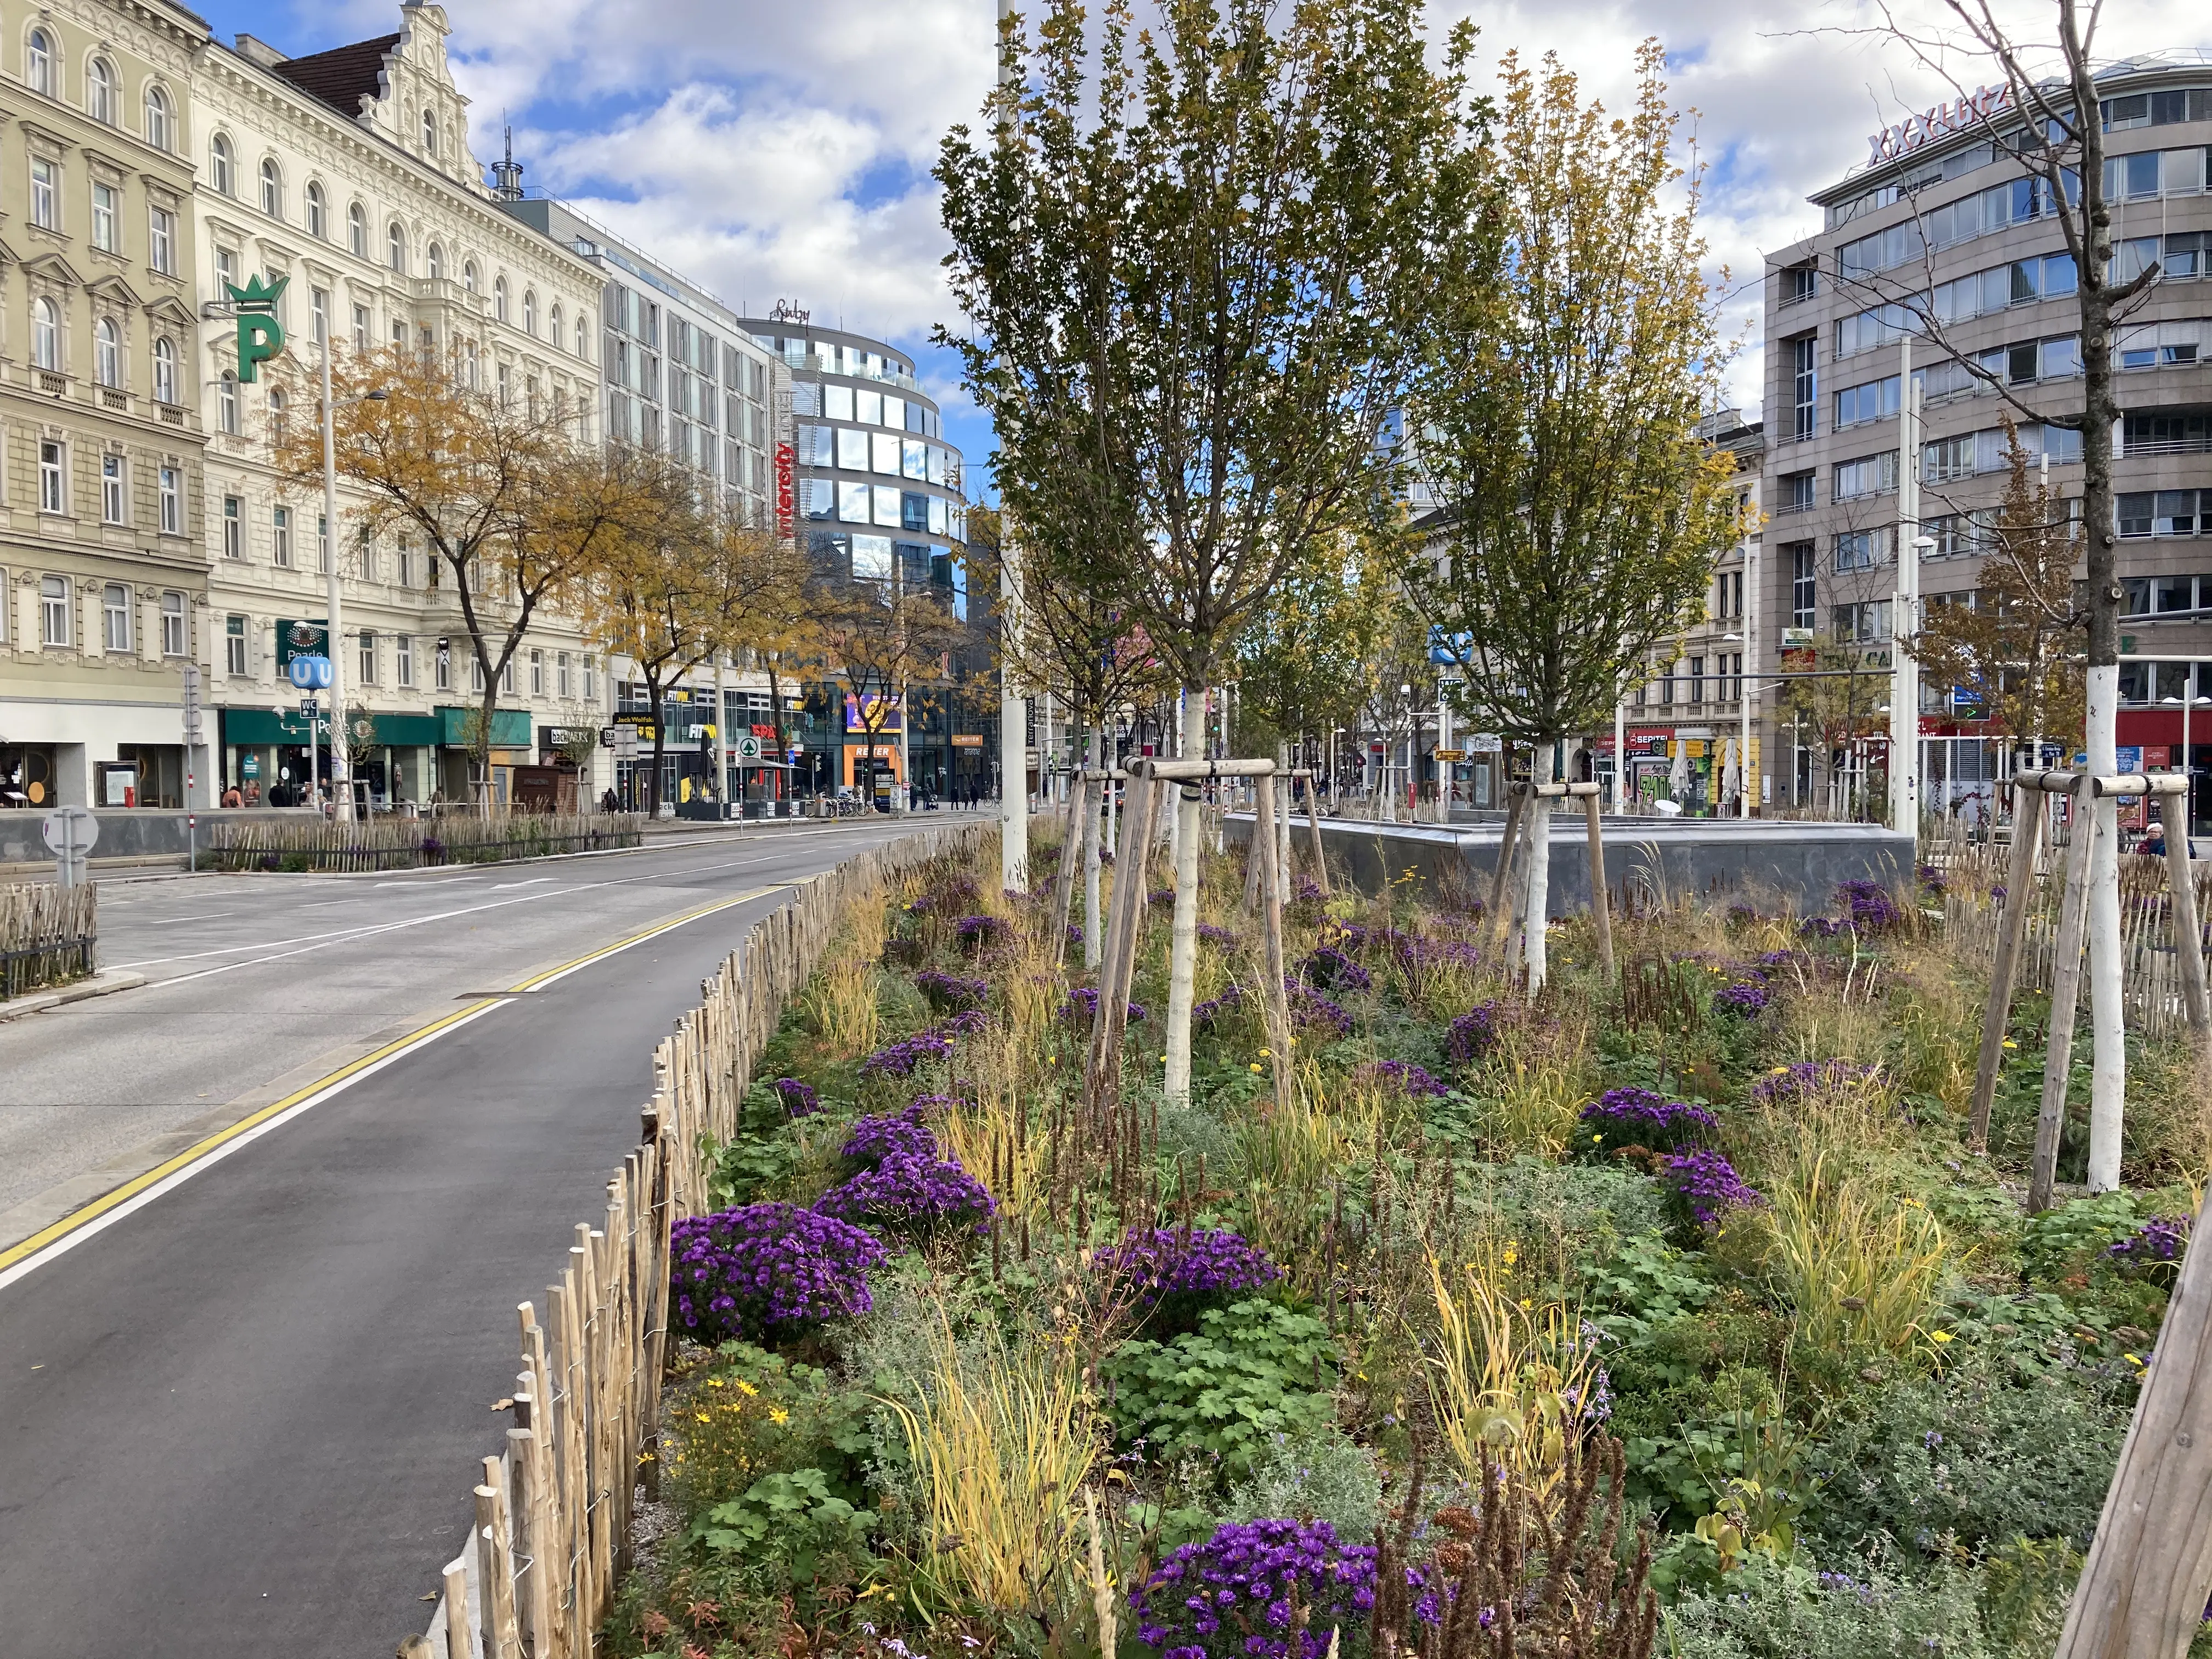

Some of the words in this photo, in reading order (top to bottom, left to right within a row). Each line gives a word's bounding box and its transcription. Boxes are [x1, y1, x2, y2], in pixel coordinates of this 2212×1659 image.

[776, 298, 810, 336] Ruby
[237, 313, 285, 383] P
[293, 664, 311, 684] U
[320, 664, 331, 684] U
[302, 701, 316, 709] WC
[318, 720, 350, 735] Pee
[752, 724, 776, 740] SPA
[856, 747, 889, 756] RETER
